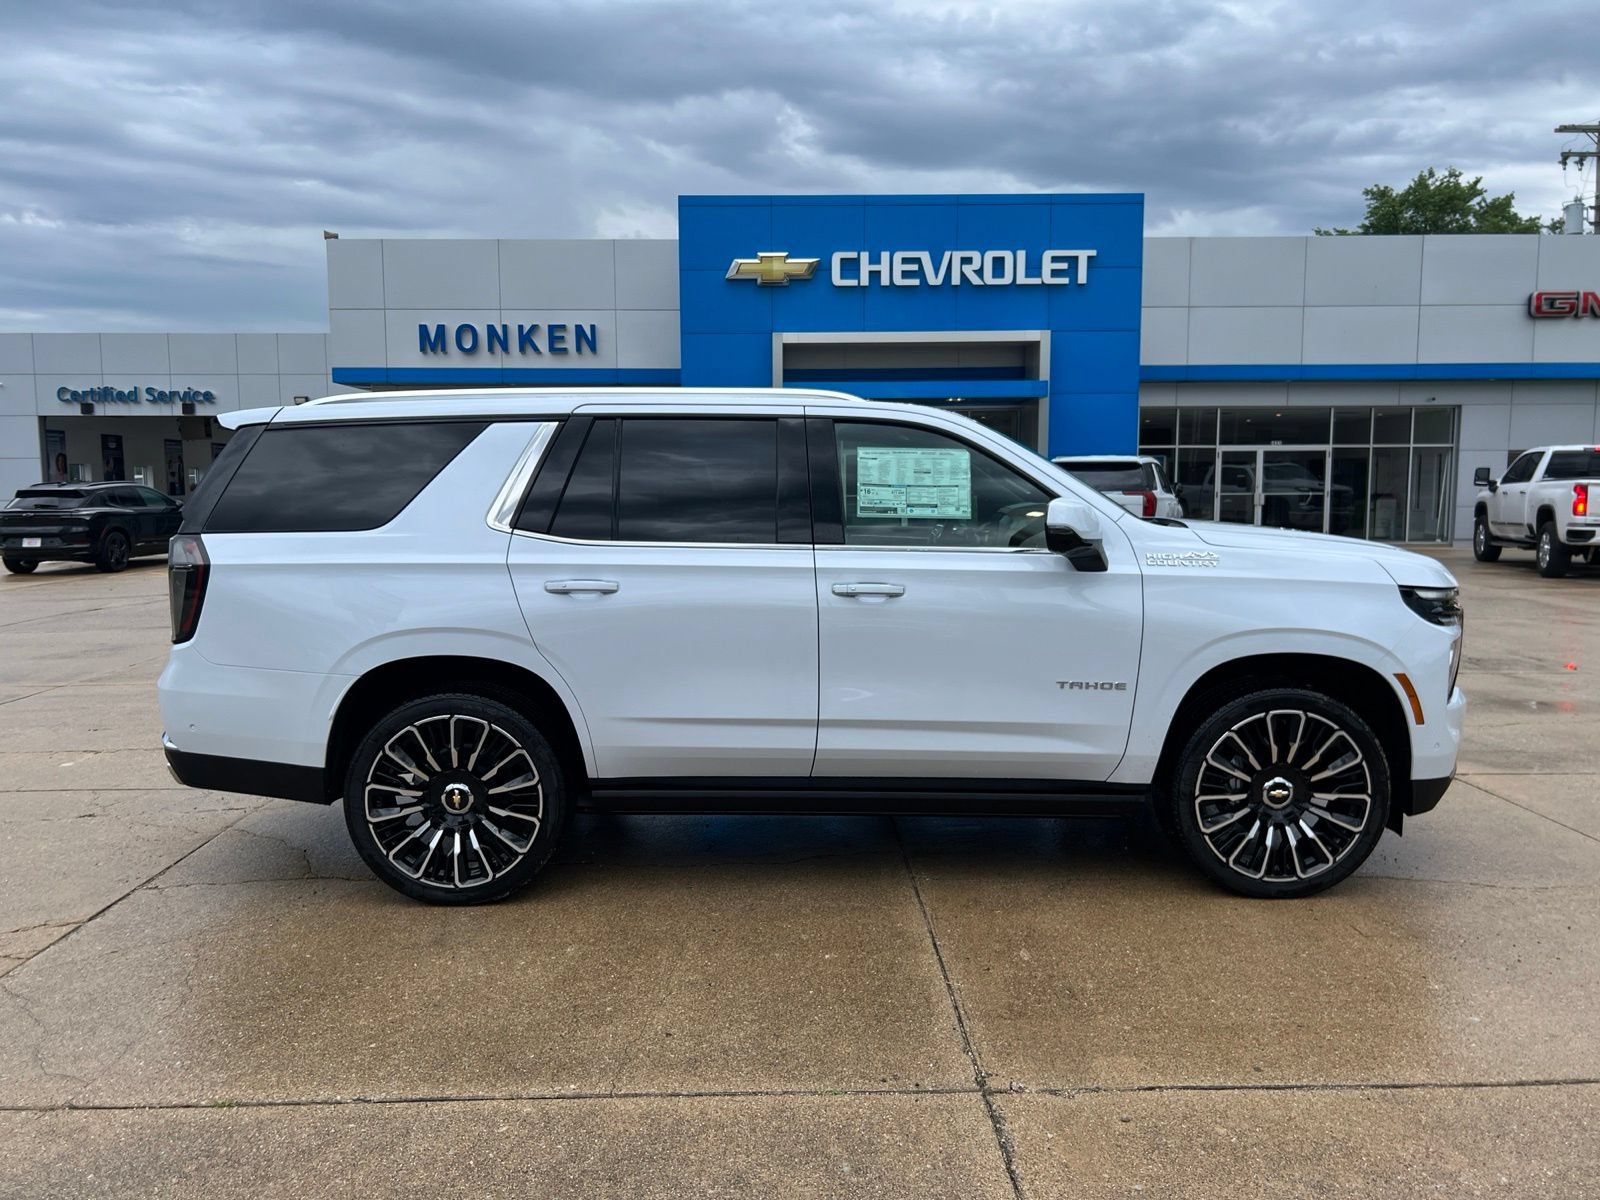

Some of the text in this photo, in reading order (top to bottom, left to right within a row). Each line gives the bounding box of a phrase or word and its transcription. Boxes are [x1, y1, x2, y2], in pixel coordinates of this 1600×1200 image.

[831, 249, 1097, 287] CHEVROLET
[418, 323, 597, 353] MONKEN
[57, 386, 214, 403] Certified Service
[1146, 552, 1183, 560] HIGH
[1056, 681, 1127, 690] TAHOE
